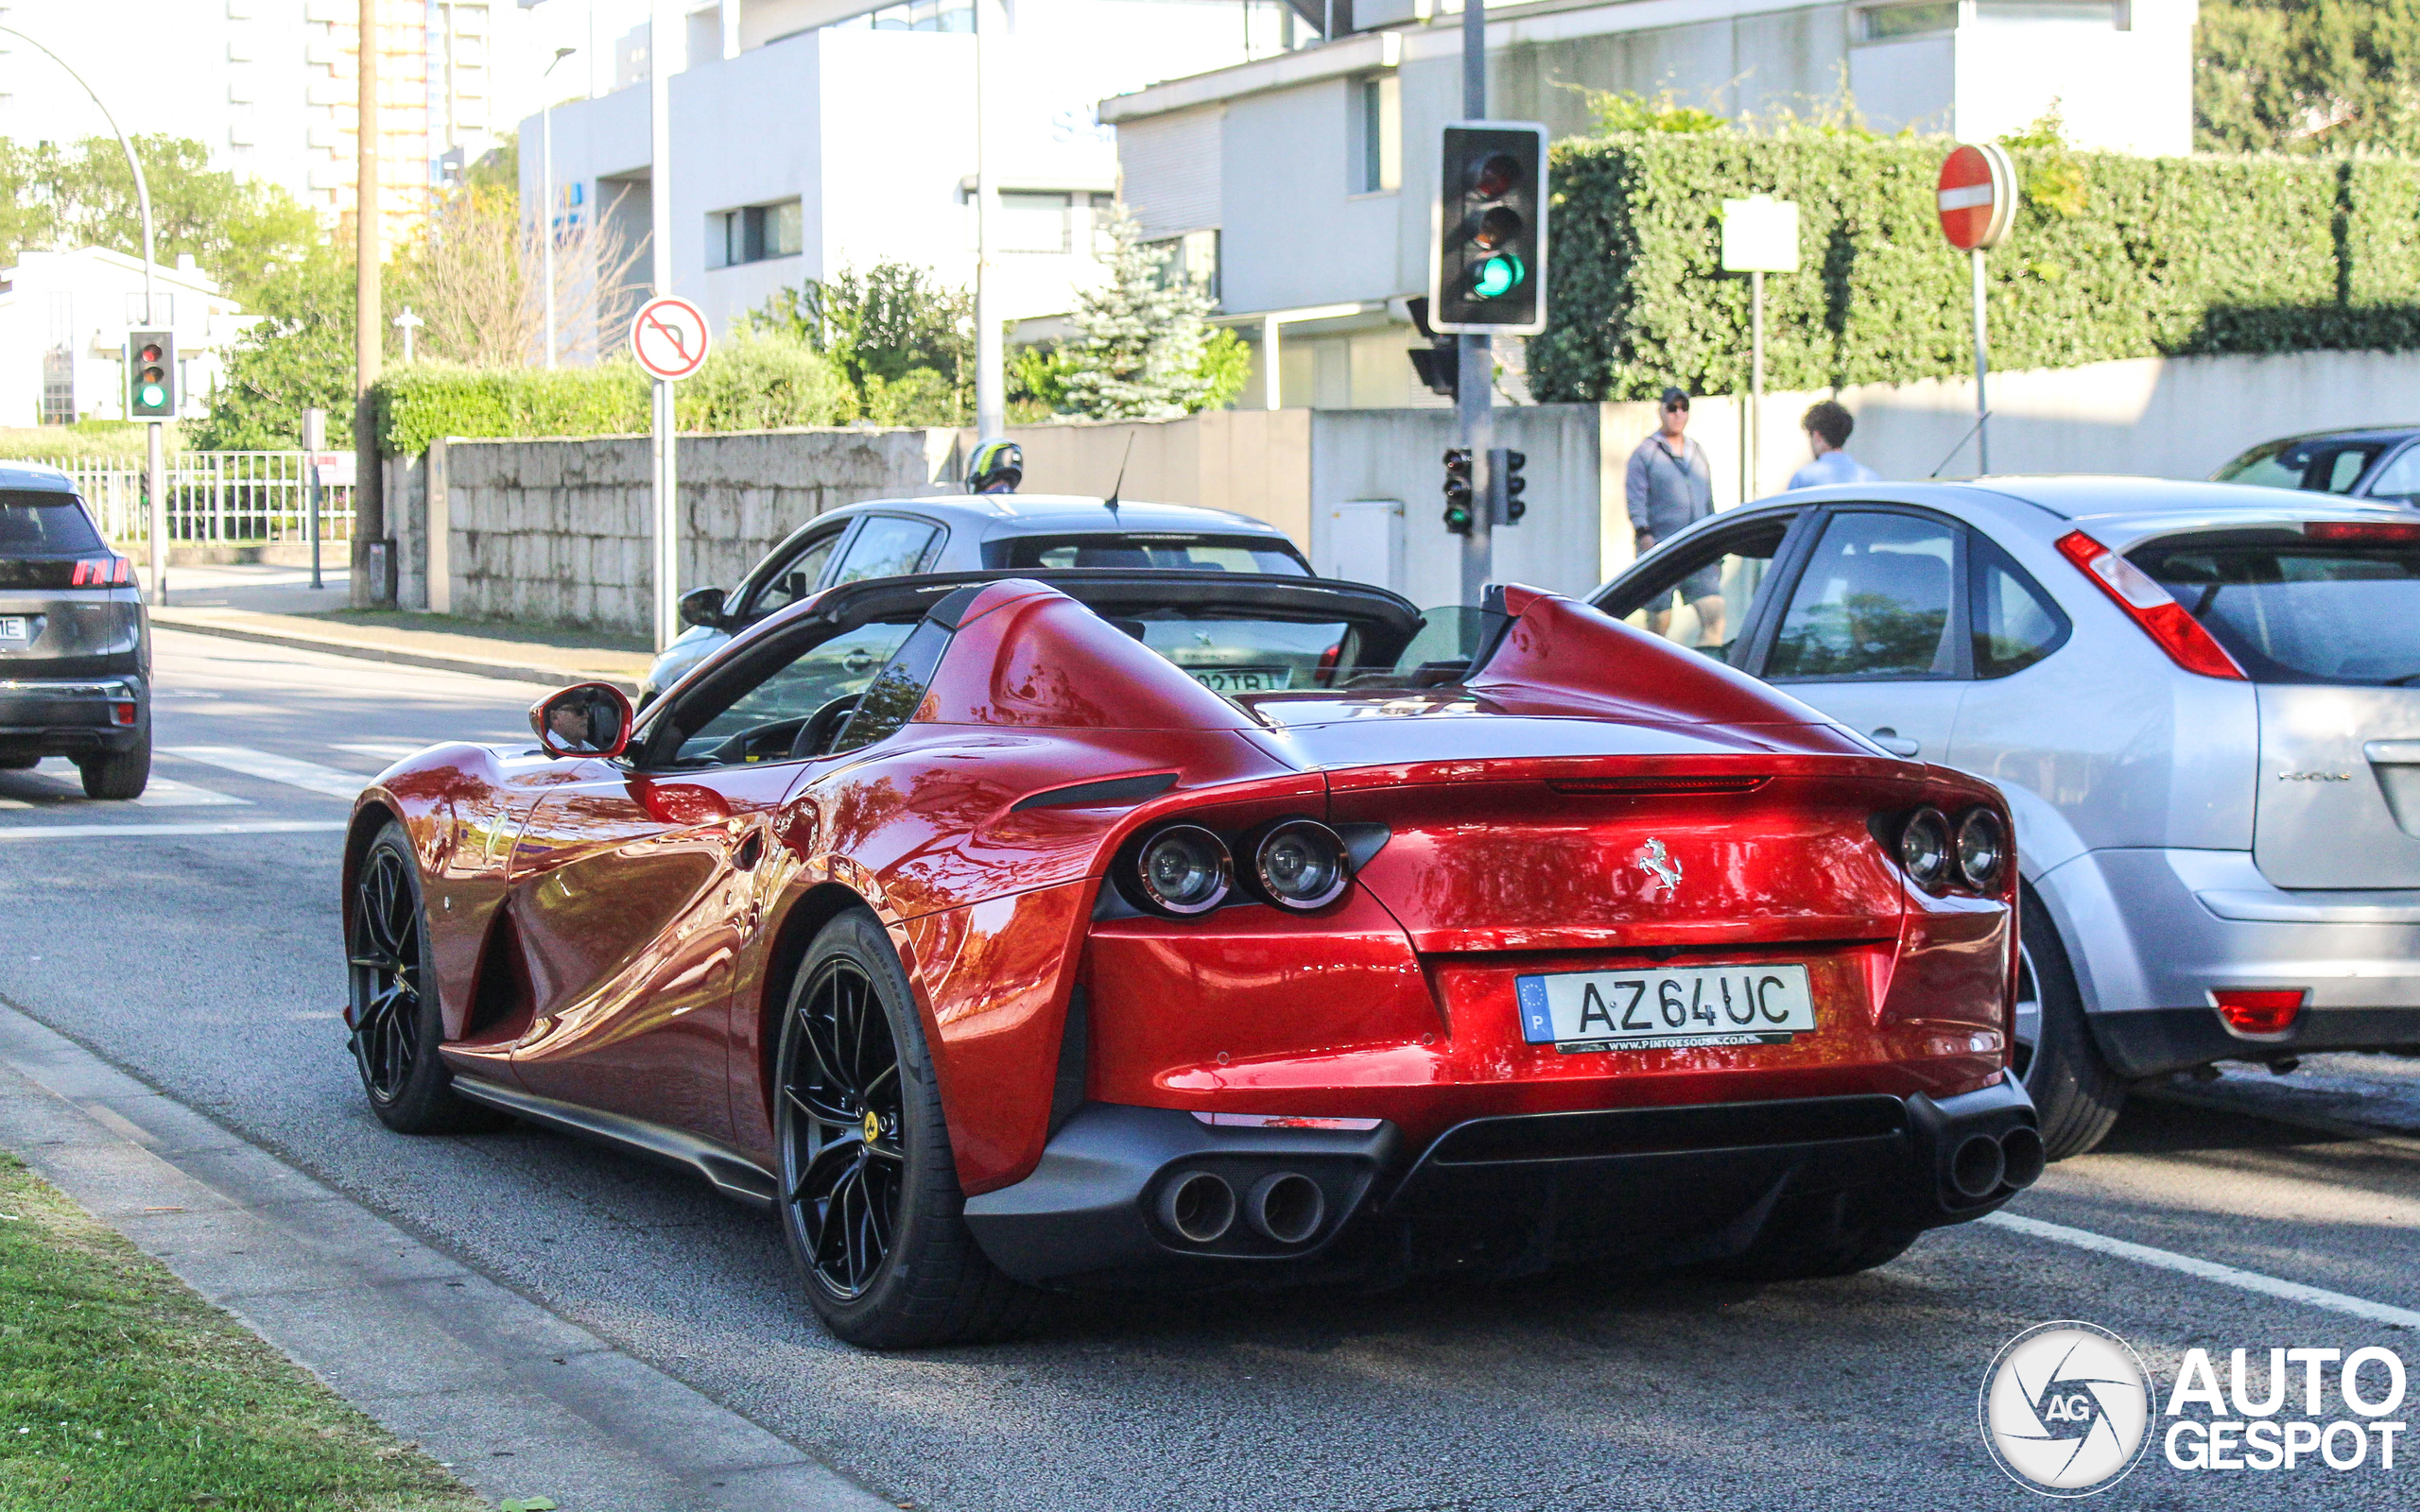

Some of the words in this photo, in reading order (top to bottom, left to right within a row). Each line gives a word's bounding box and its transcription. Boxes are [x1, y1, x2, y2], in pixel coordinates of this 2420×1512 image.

[2278, 771, 2351, 782] FOCUS
[1532, 1015, 1544, 1030] P
[1579, 975, 1789, 1033] AZ64UC
